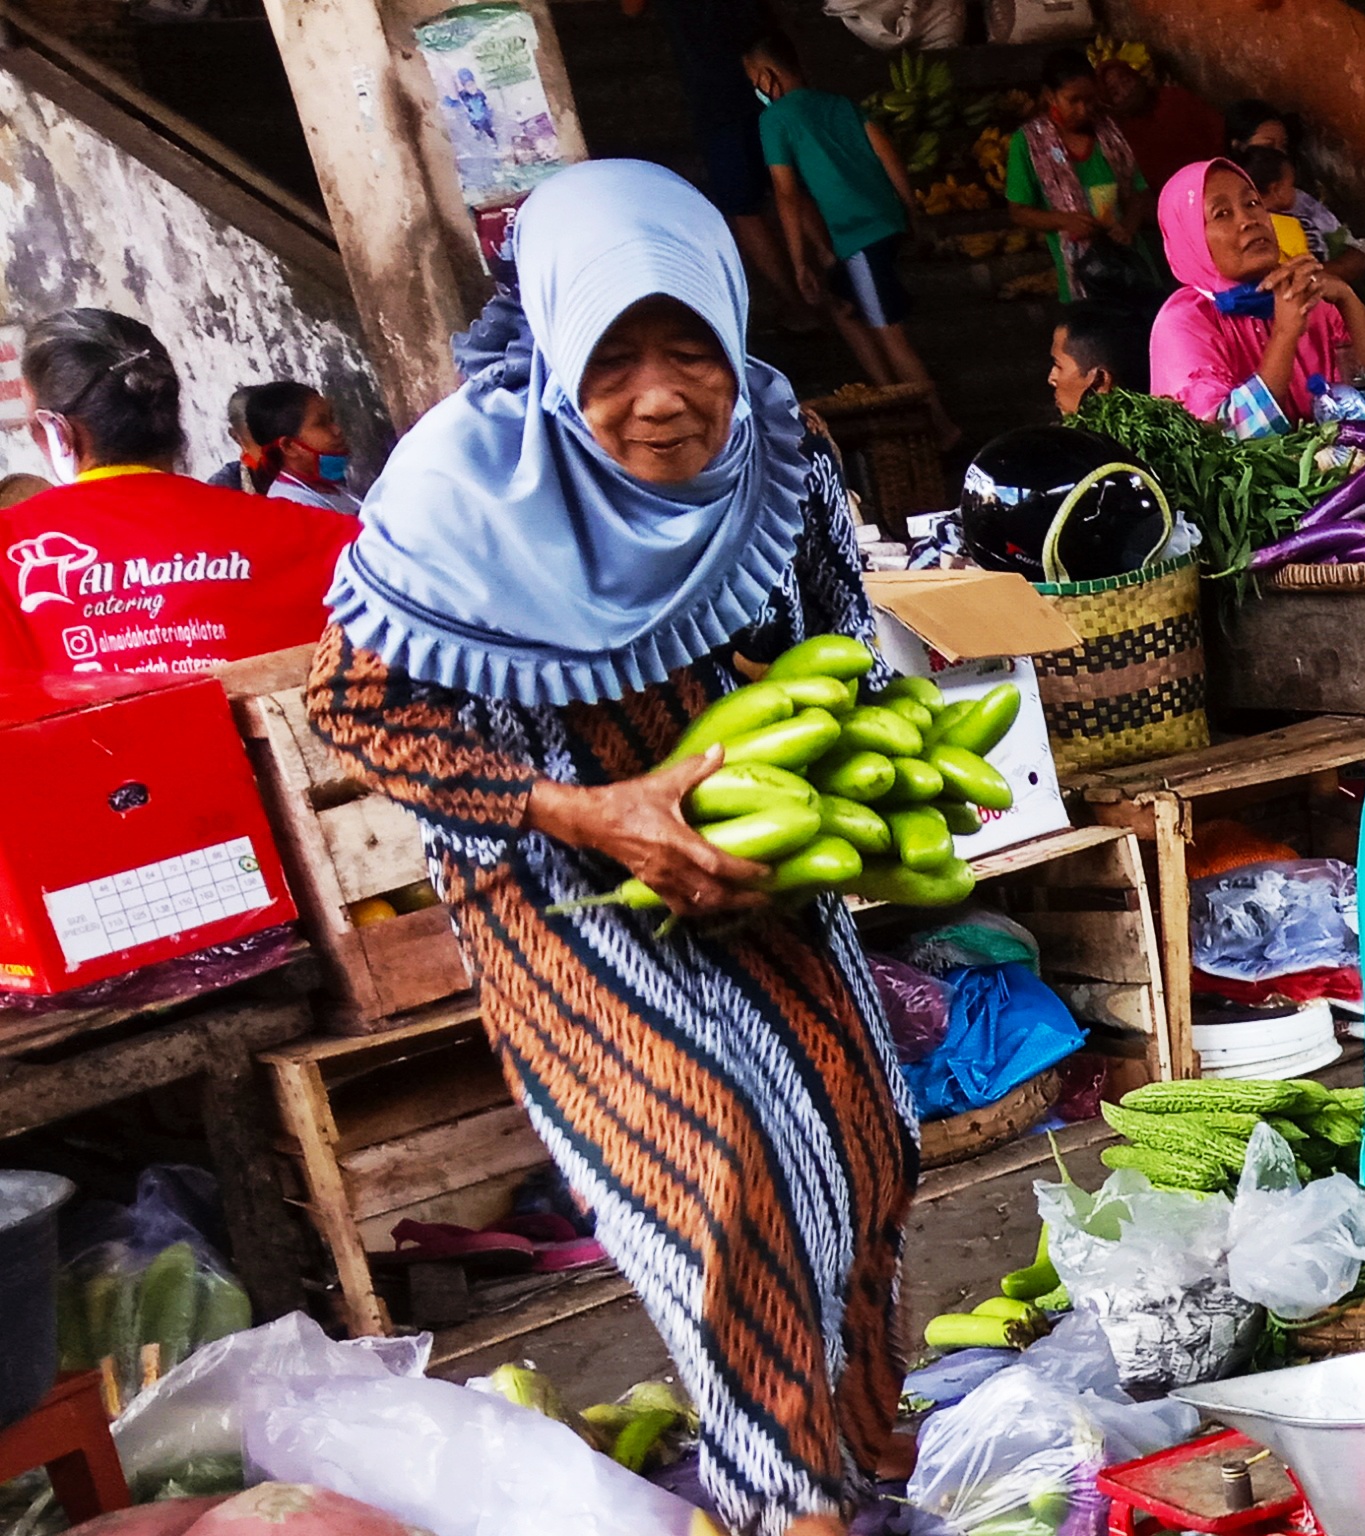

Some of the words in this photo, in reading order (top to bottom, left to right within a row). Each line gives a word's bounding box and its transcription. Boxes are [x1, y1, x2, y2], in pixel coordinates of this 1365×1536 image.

[78, 562, 114, 596] Al
[122, 551, 252, 590] Maidah
[83, 588, 166, 619] catering
[99, 618, 227, 653] almaidahcateringklaten
